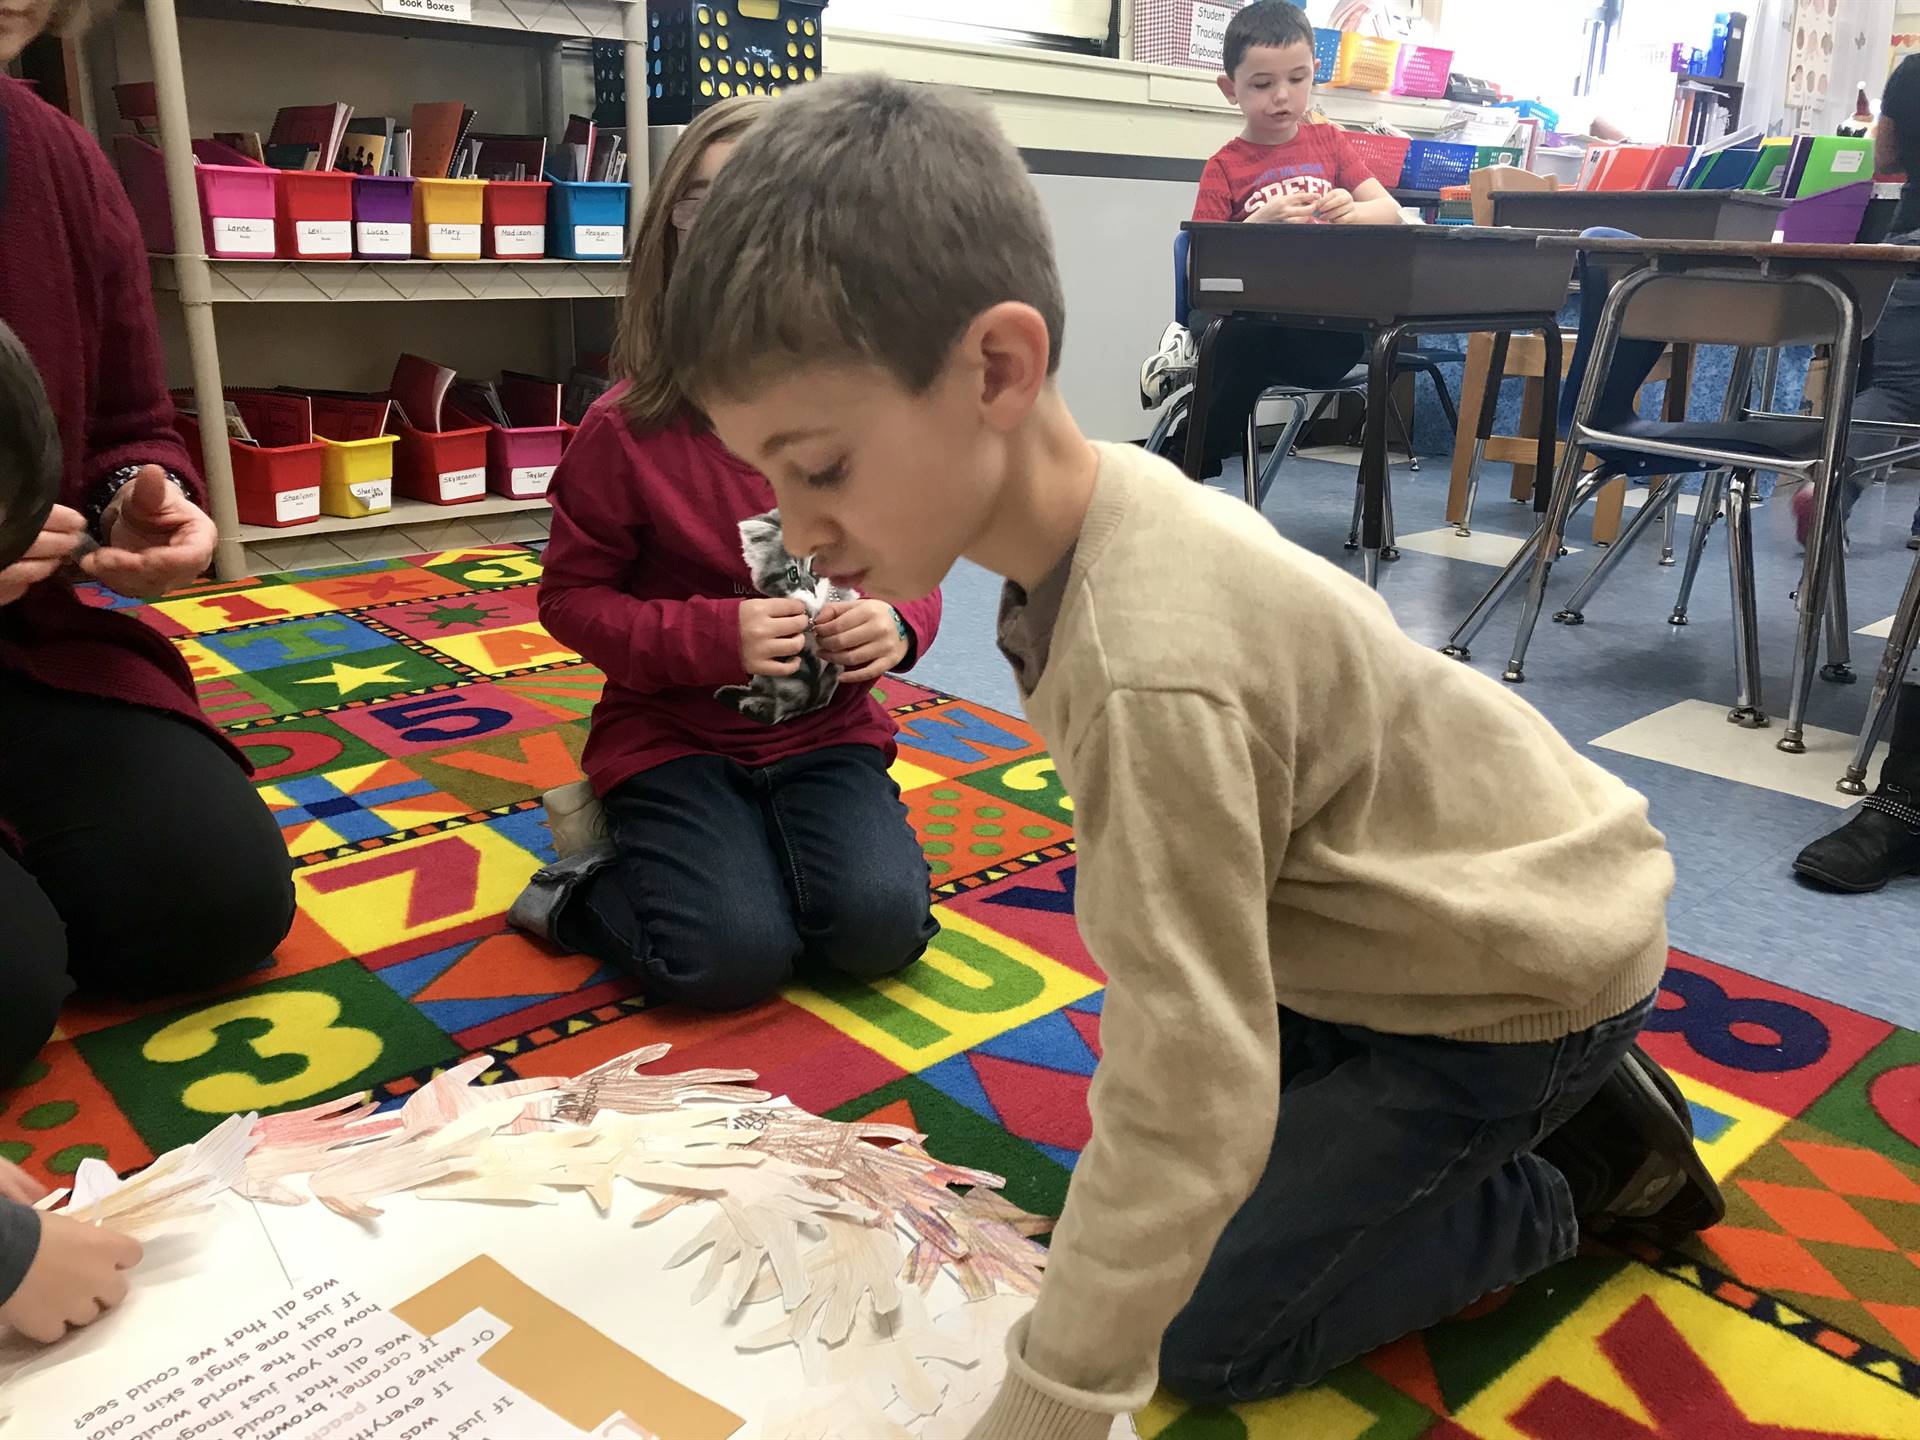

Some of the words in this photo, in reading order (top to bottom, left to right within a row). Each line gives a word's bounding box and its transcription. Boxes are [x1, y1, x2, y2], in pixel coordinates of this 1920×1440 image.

[400, 0, 422, 8] Book
[426, 0, 454, 12] Boxes
[1197, 6, 1225, 22] Student
[1196, 25, 1224, 44] Tracking
[227, 224, 252, 233] Lance
[367, 228, 390, 236] Lucas
[440, 227, 461, 238] Mary
[501, 229, 532, 237] Madison
[370, 694, 513, 742] 5
[301, 834, 481, 930] 7
[142, 990, 384, 1114] 3
[302, 1278, 339, 1301] was
[341, 1290, 362, 1309] If
[272, 1300, 297, 1320] all
[297, 1303, 334, 1331] just
[343, 1303, 382, 1327] how
[223, 1318, 268, 1348] that
[255, 1329, 289, 1353] one
[301, 1326, 338, 1352] dull
[374, 1332, 412, 1356] was
[471, 1329, 495, 1347] Or
[185, 1347, 217, 1367] we
[325, 1336, 363, 1358] Can
[419, 1336, 440, 1355] If
[191, 1352, 251, 1387] single
[259, 1351, 296, 1373] the
[285, 1357, 322, 1383] you
[343, 1355, 369, 1375] all
[406, 1346, 466, 1386] white?
[125, 1366, 180, 1402] could
[330, 1351, 412, 1400] caramel,
[143, 1387, 186, 1414] skin
[198, 1373, 256, 1410] world
[240, 1381, 281, 1411] just
[295, 1375, 339, 1404] that
[374, 1385, 401, 1405] Or
[432, 1381, 454, 1399] If
[74, 1398, 120, 1430] see?
[492, 1395, 514, 1415] If
[232, 1404, 287, 1439] could
[399, 1416, 439, 1440] was
[448, 1410, 487, 1440] just
